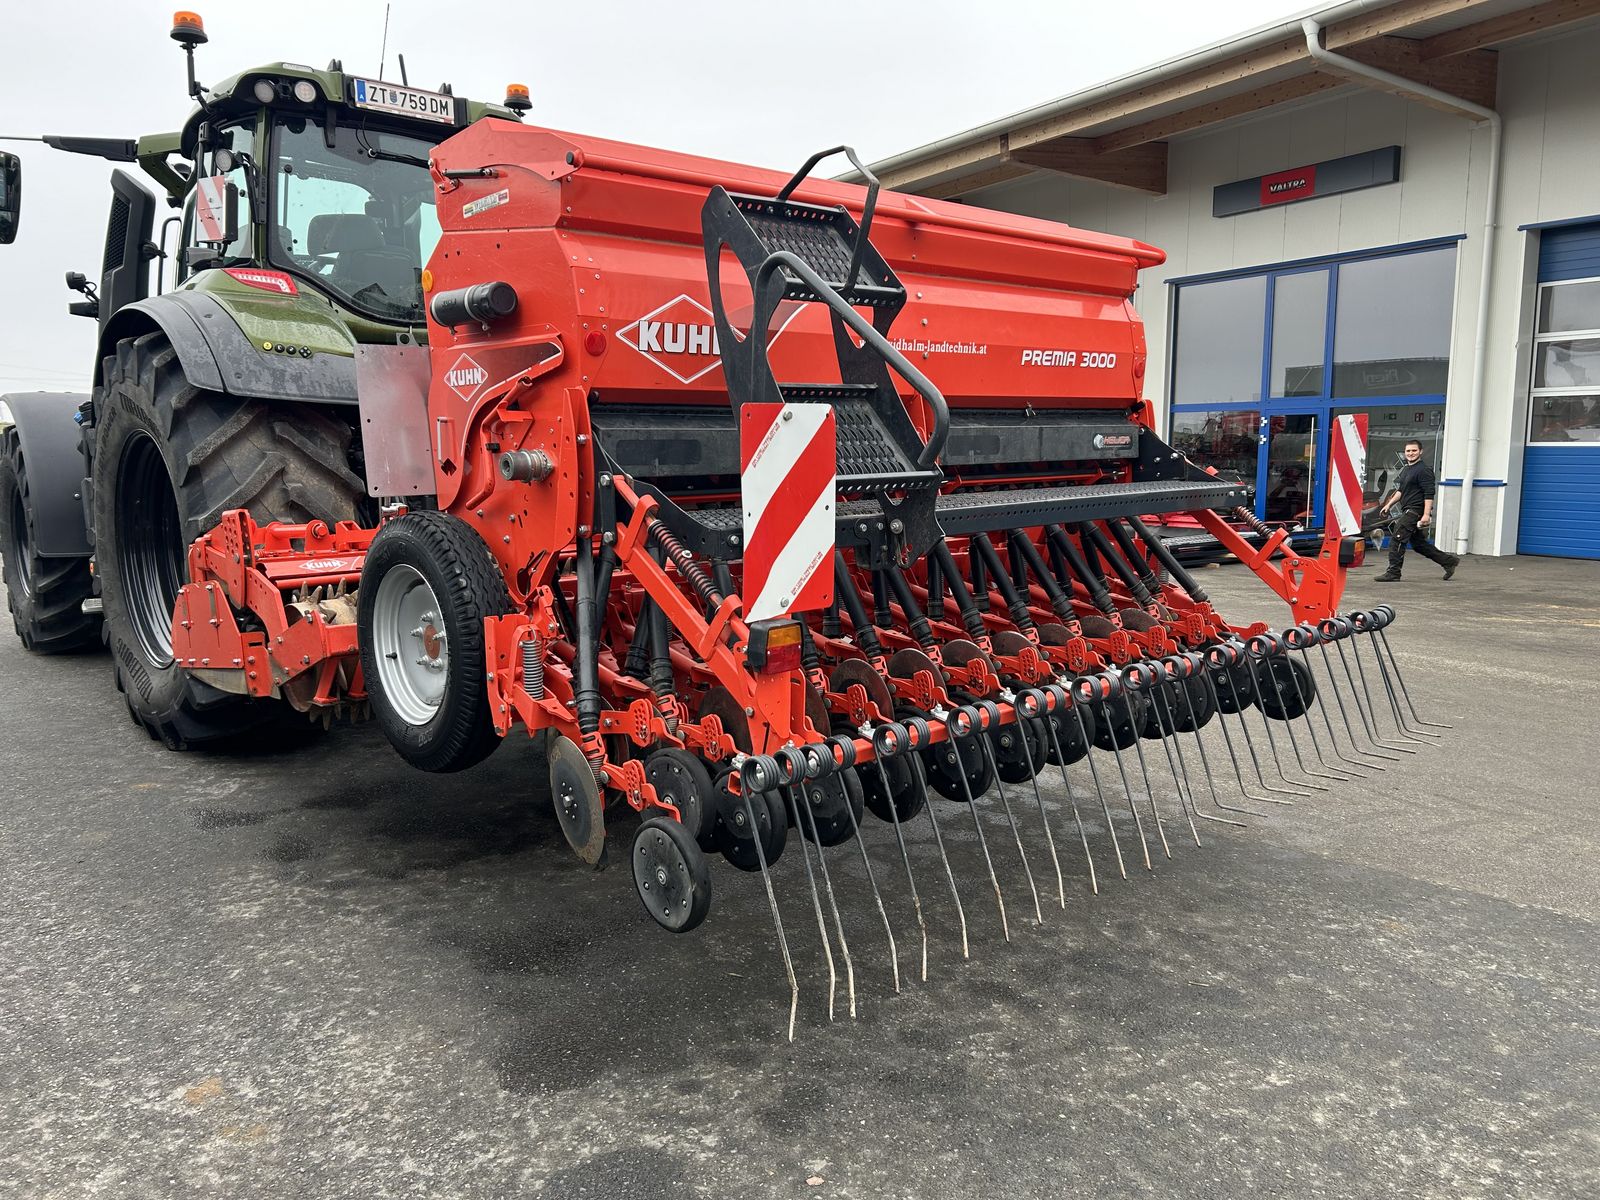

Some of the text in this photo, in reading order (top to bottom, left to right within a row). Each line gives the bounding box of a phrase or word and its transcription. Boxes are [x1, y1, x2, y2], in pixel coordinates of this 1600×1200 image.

[369, 86, 387, 104] ZT
[400, 92, 427, 111] 759
[431, 98, 449, 116] DM
[1270, 179, 1306, 193] VALTRA
[1021, 349, 1117, 369] PREMIA 3000
[449, 368, 483, 387] KUHN
[305, 560, 341, 570] KUHN
